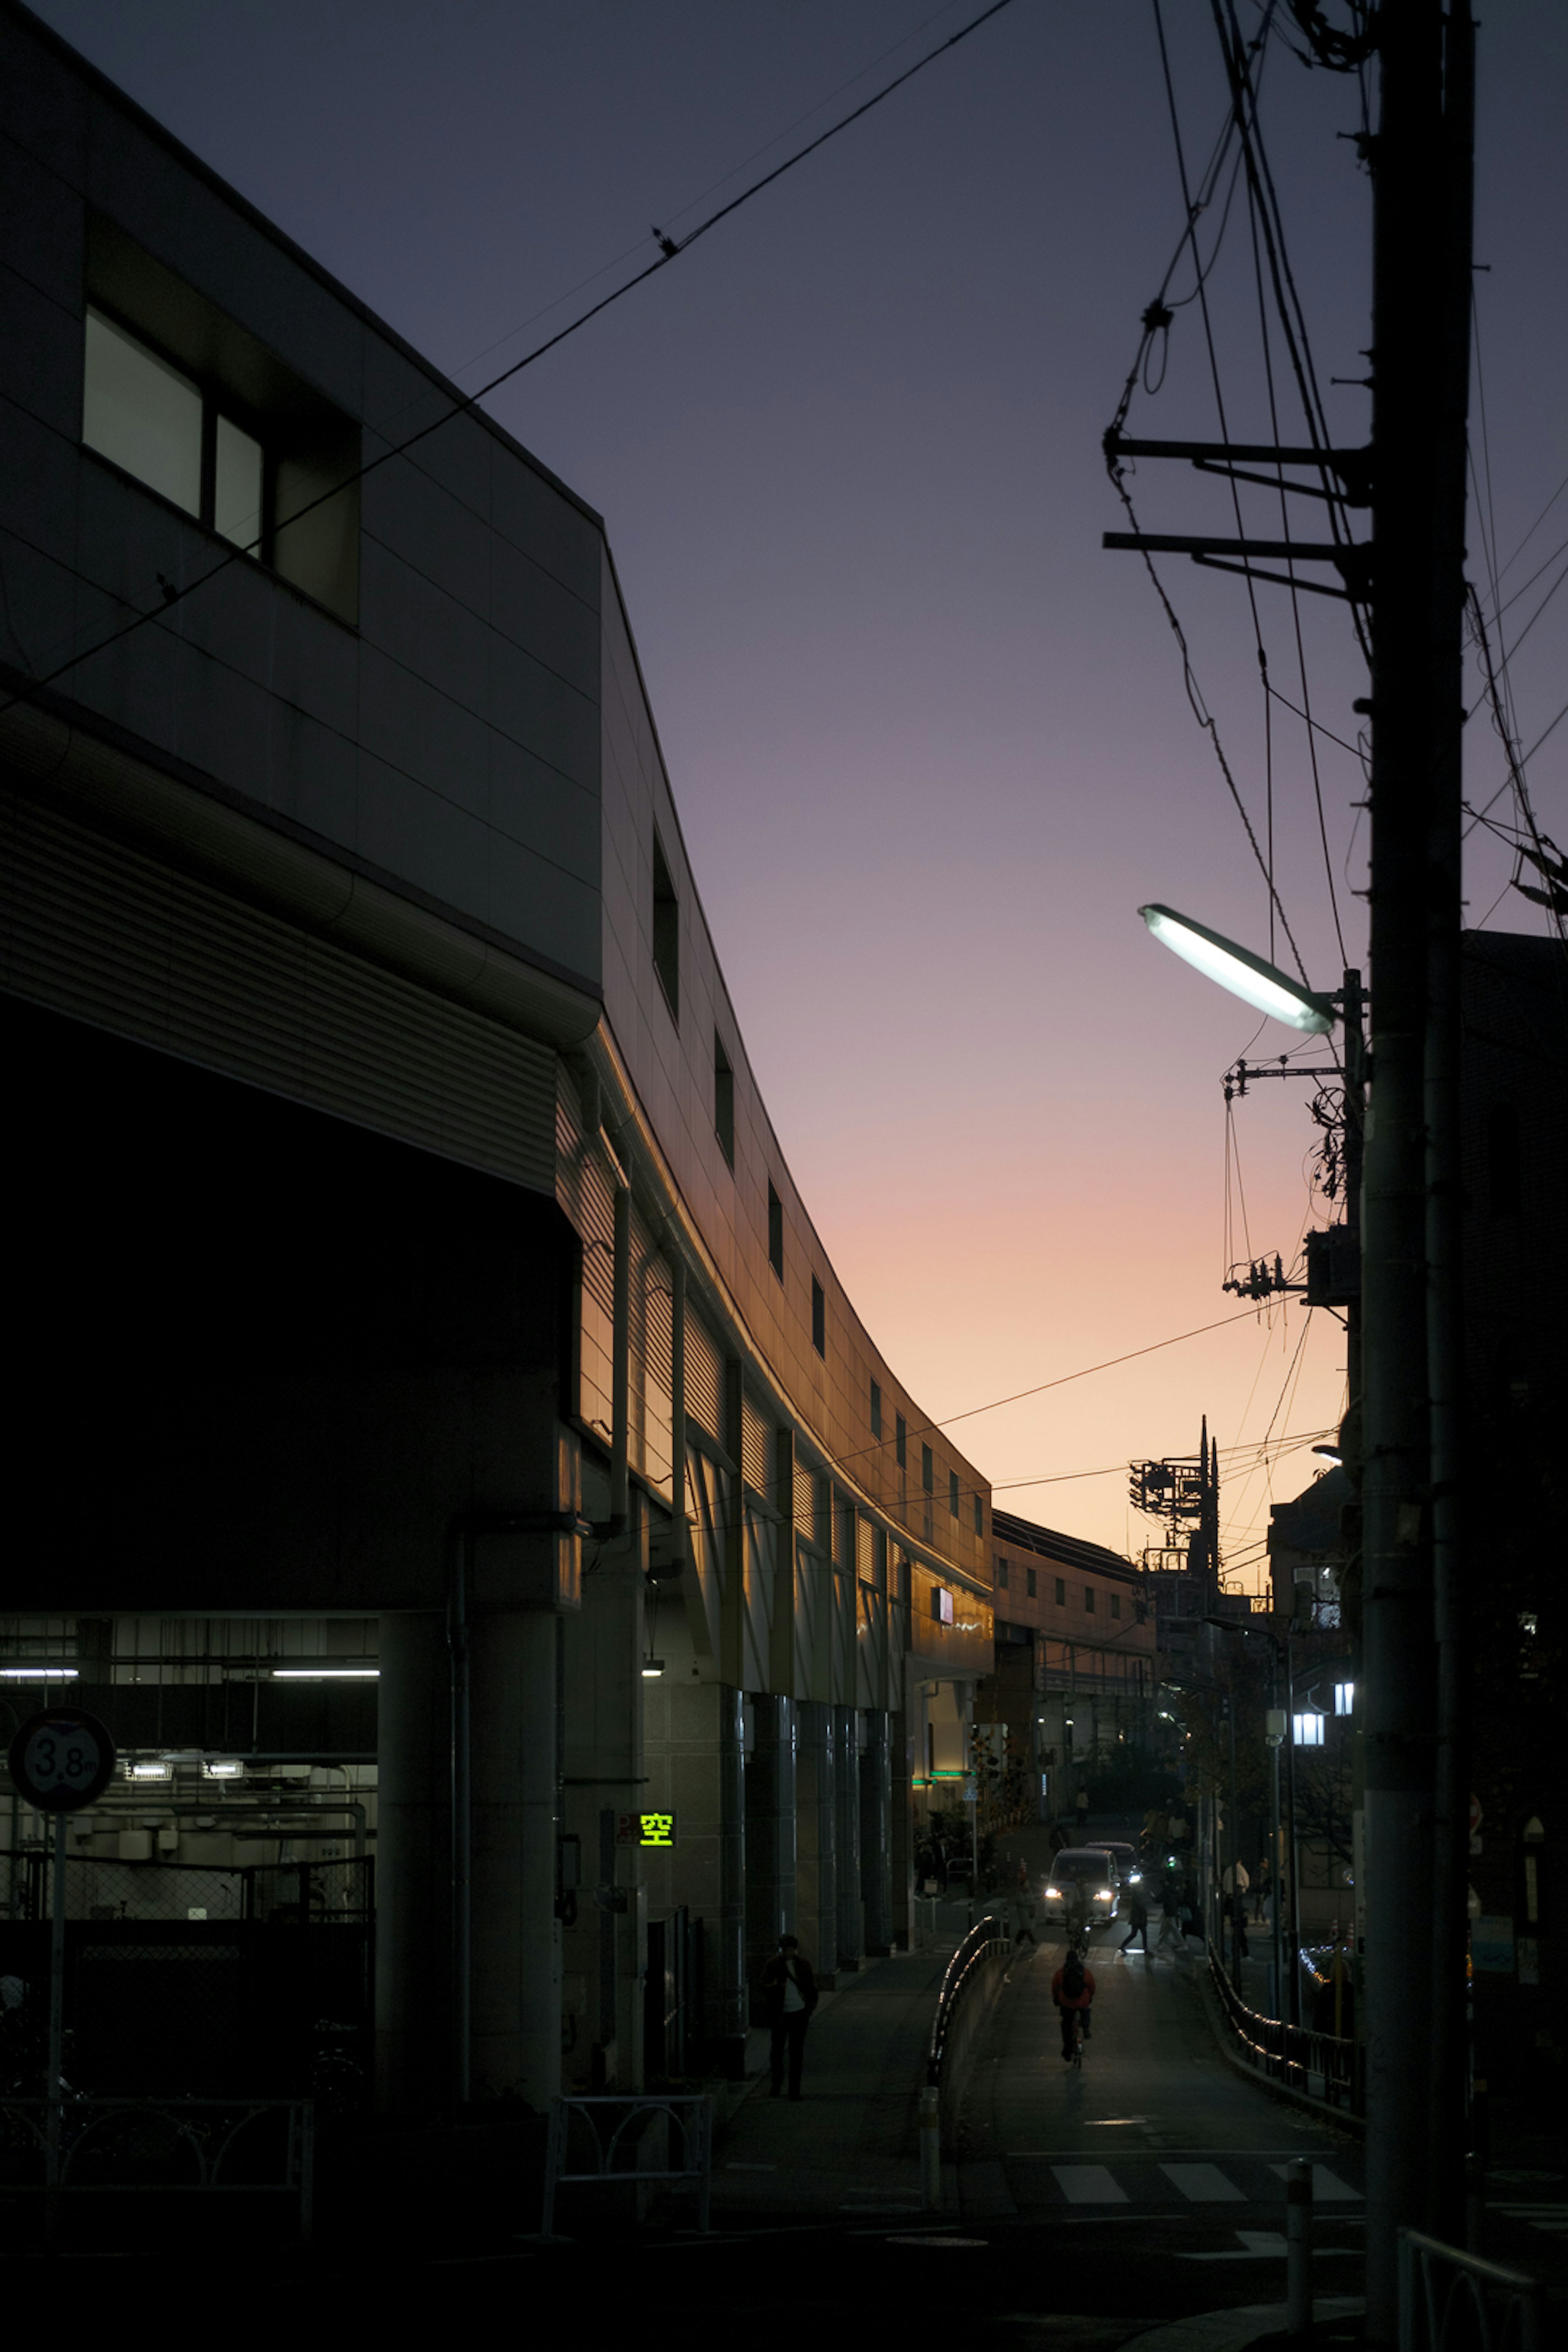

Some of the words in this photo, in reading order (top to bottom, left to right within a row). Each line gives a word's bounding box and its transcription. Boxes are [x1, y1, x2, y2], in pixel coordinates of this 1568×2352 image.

[35, 1738, 96, 1781] 3.8m
[618, 1814, 630, 1835] P
[639, 1812, 673, 1846] 空
